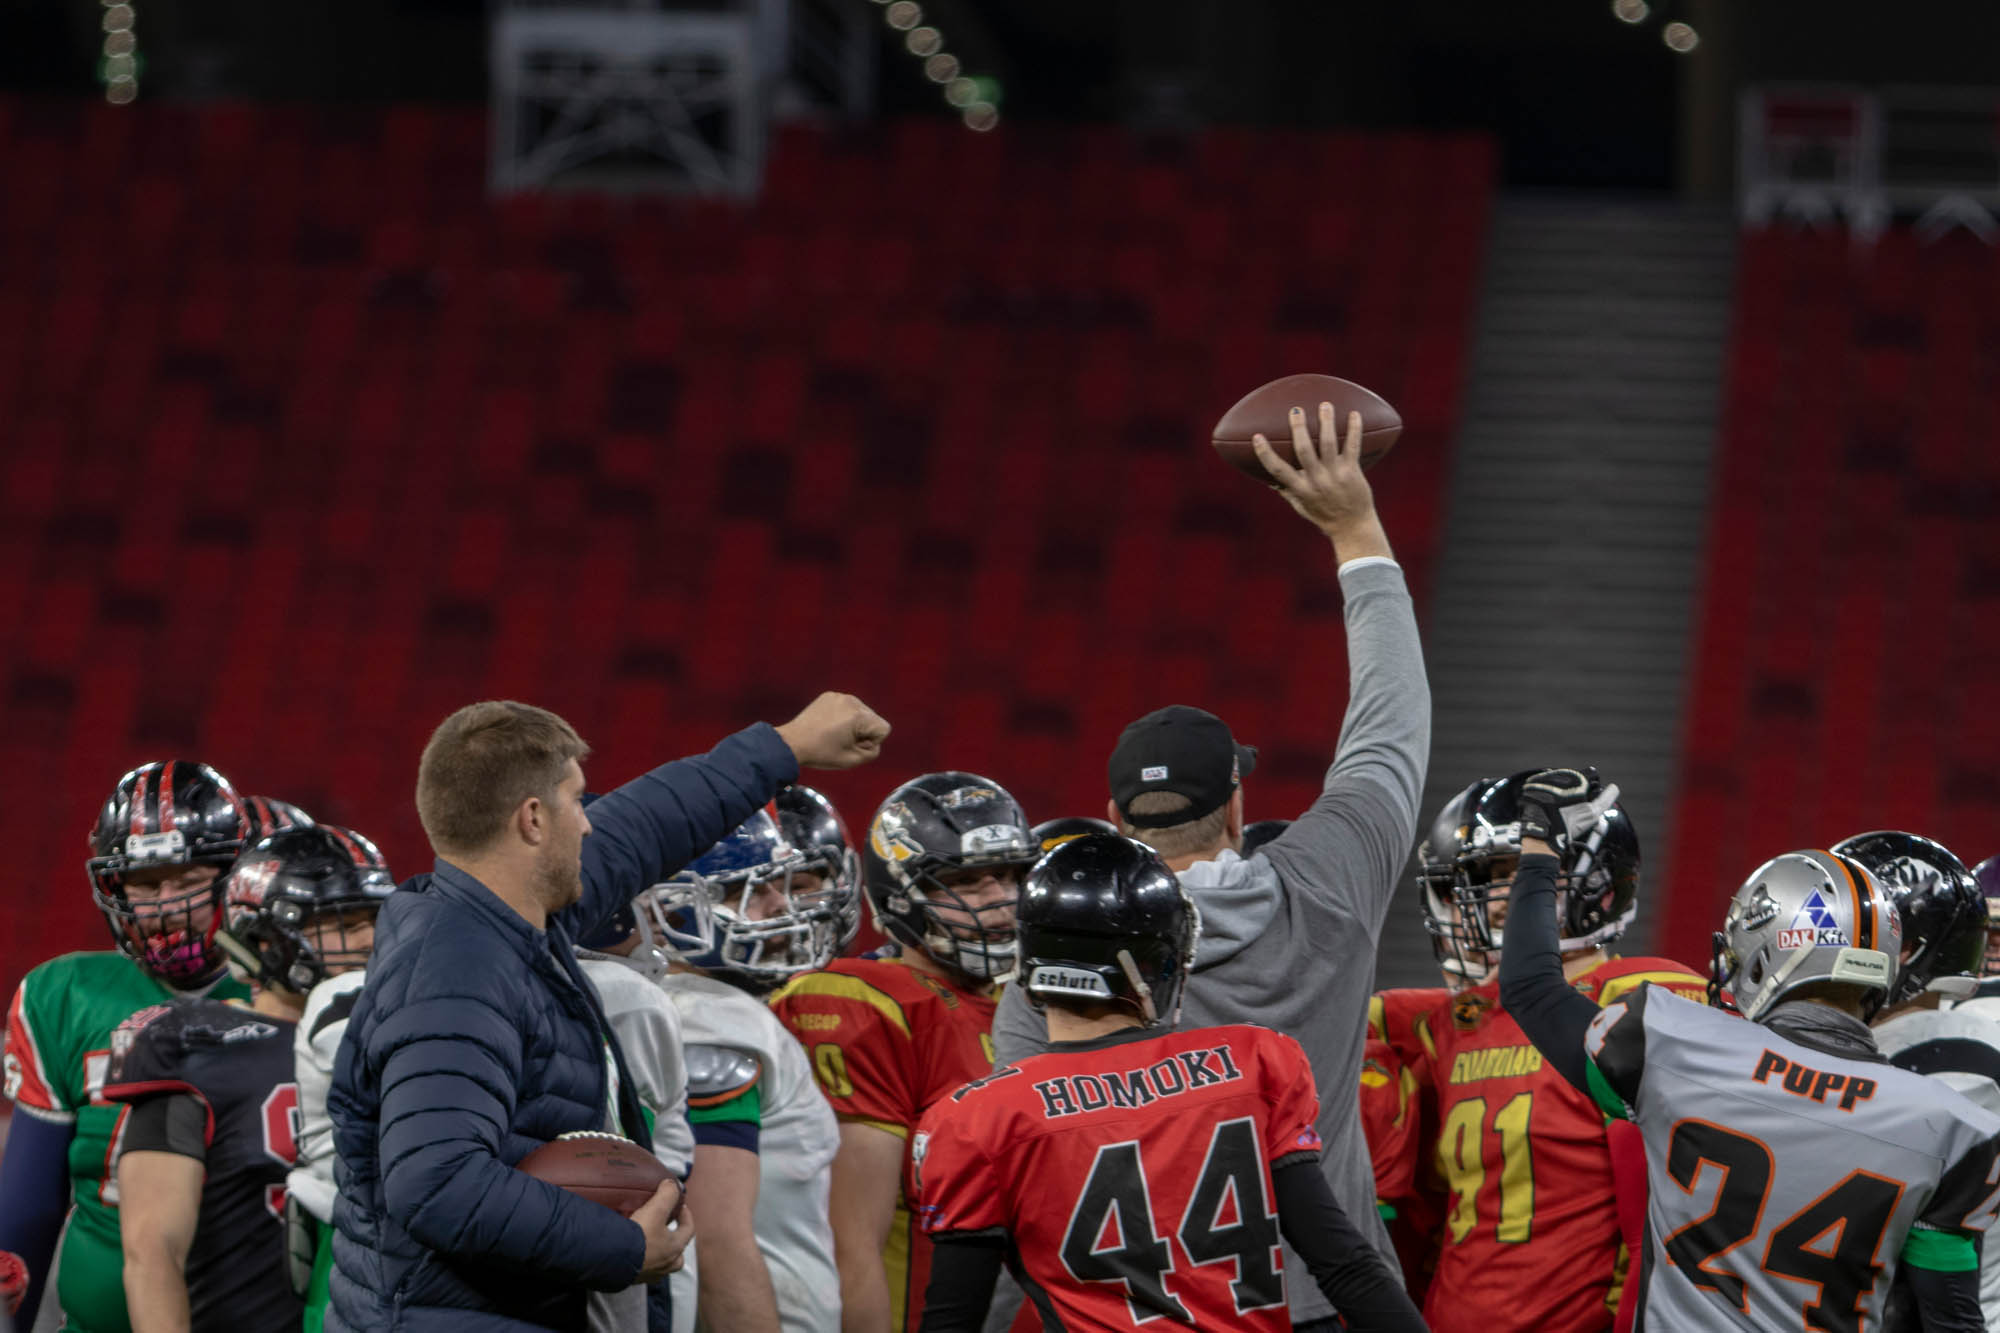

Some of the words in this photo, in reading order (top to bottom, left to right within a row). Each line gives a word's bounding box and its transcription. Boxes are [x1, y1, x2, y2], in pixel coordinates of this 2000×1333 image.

[1780, 930, 1813, 947] DAK
[1038, 972, 1097, 990] schutt
[1033, 1044, 1244, 1118] HOMOKI
[1751, 1048, 1878, 1113] PUPP
[1437, 1089, 1536, 1244] 91
[1059, 1115, 1287, 1326] 44
[1664, 1117, 1907, 1333] 24
